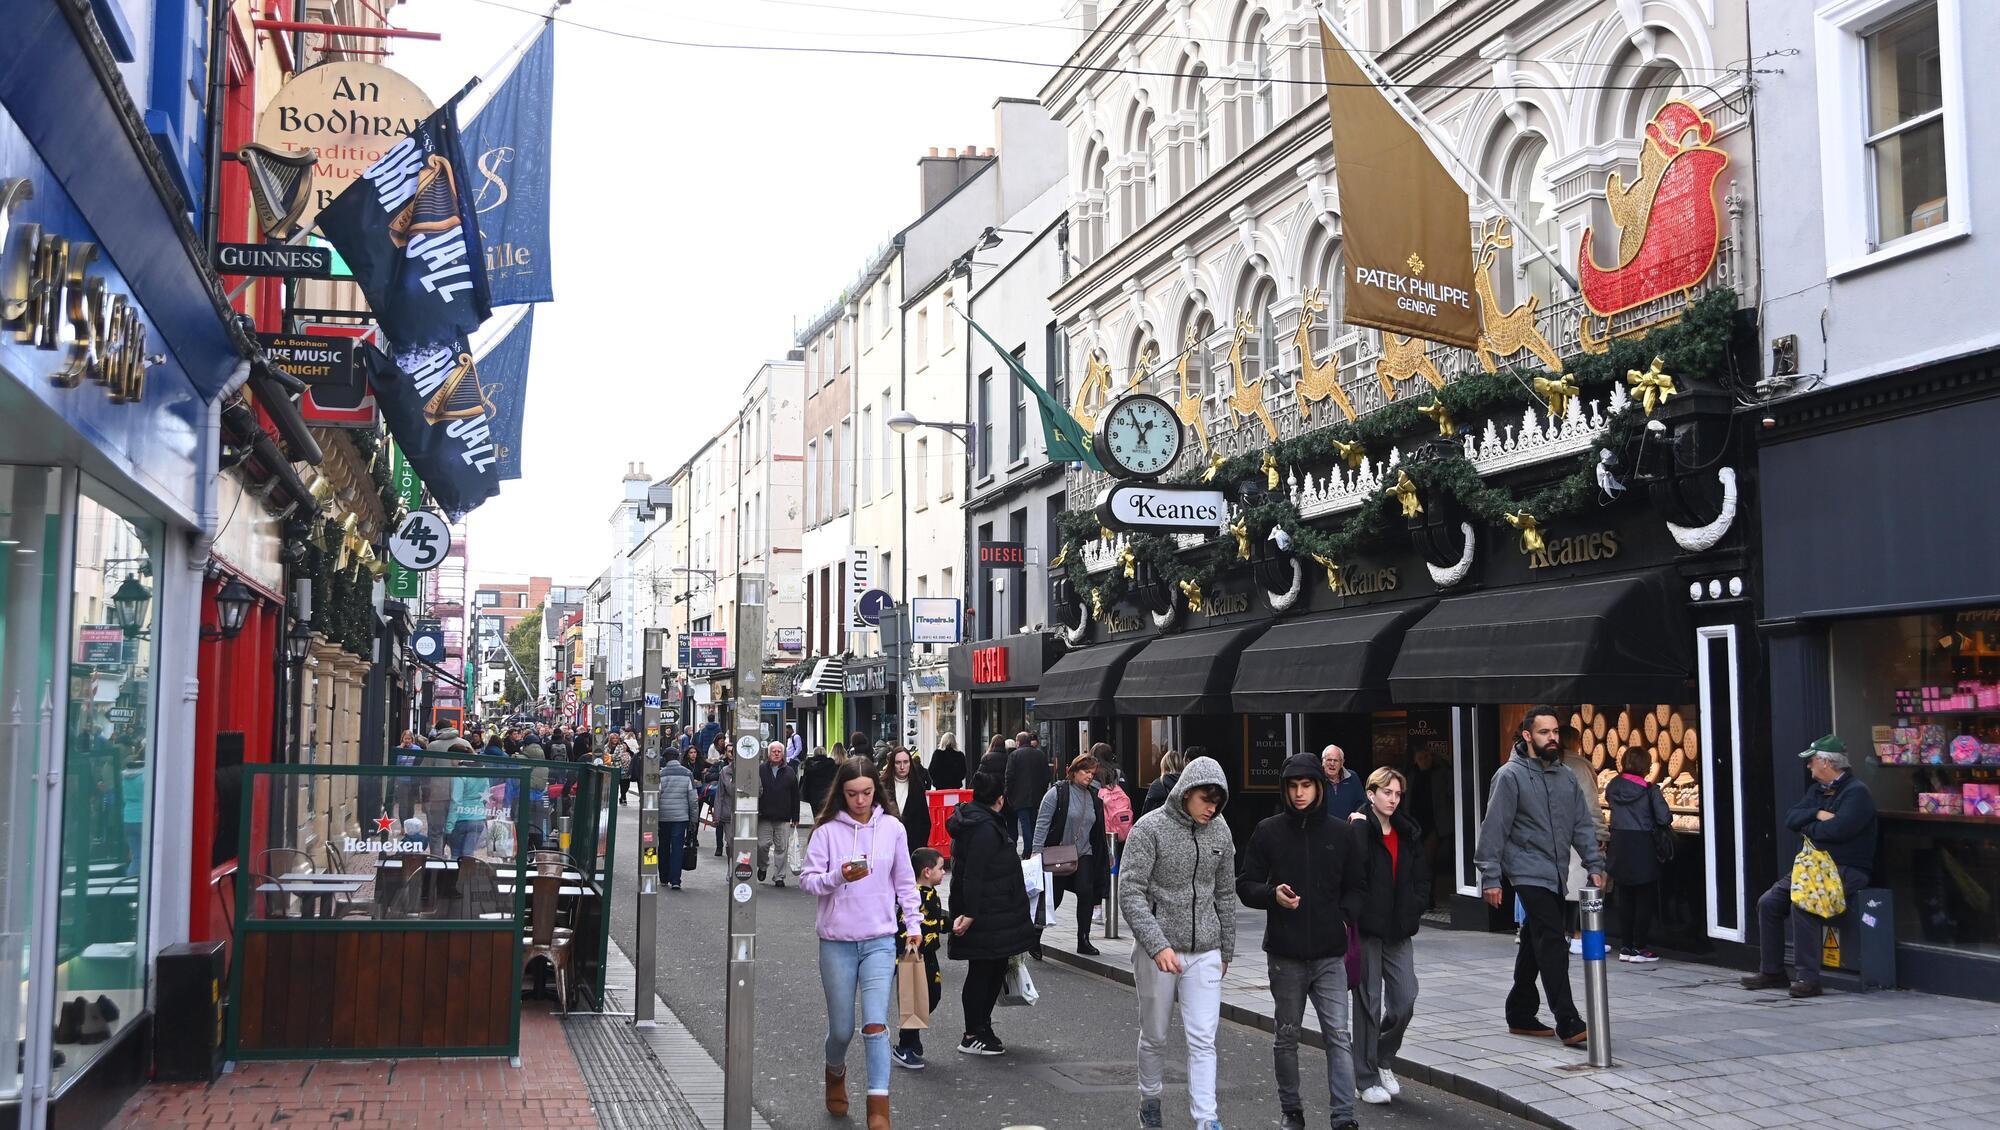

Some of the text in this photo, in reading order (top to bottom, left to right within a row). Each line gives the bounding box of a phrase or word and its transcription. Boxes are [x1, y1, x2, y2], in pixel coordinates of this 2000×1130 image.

[332, 76, 379, 102] An
[281, 142, 390, 161] Traditio
[313, 163, 374, 180] Mus
[219, 247, 323, 269] GUINNESS
[484, 243, 532, 271] ille
[1355, 266, 1471, 309] PATEK PHILIPPE
[1396, 296, 1438, 317] GENEVE
[294, 349, 343, 363] MUSIC
[276, 363, 331, 376] ONIGHT
[1137, 405, 1147, 414] 12
[1152, 410, 1158, 418] 1
[1116, 418, 1125, 426] 10
[1161, 420, 1168, 428] 2
[1112, 431, 1119, 440] 9
[1164, 434, 1171, 443] 3
[1115, 445, 1122, 453] 8
[1161, 448, 1167, 456] 4
[1125, 456, 1131, 464] 7
[1137, 460, 1144, 469] 6
[1151, 457, 1158, 466] 5
[1129, 494, 1218, 521] Keanes
[980, 547, 1024, 562] DIESEL
[1520, 529, 1618, 570] Keanes
[1337, 567, 1397, 597] Keanes
[1201, 591, 1249, 618] Keanes
[1103, 609, 1142, 634] Keanes
[972, 646, 1009, 683] DIESEL
[660, 710, 675, 719] TTOO
[1408, 728, 1438, 736] OMEGA
[1250, 768, 1280, 776] TUDOR
[343, 836, 424, 853] Heineken
